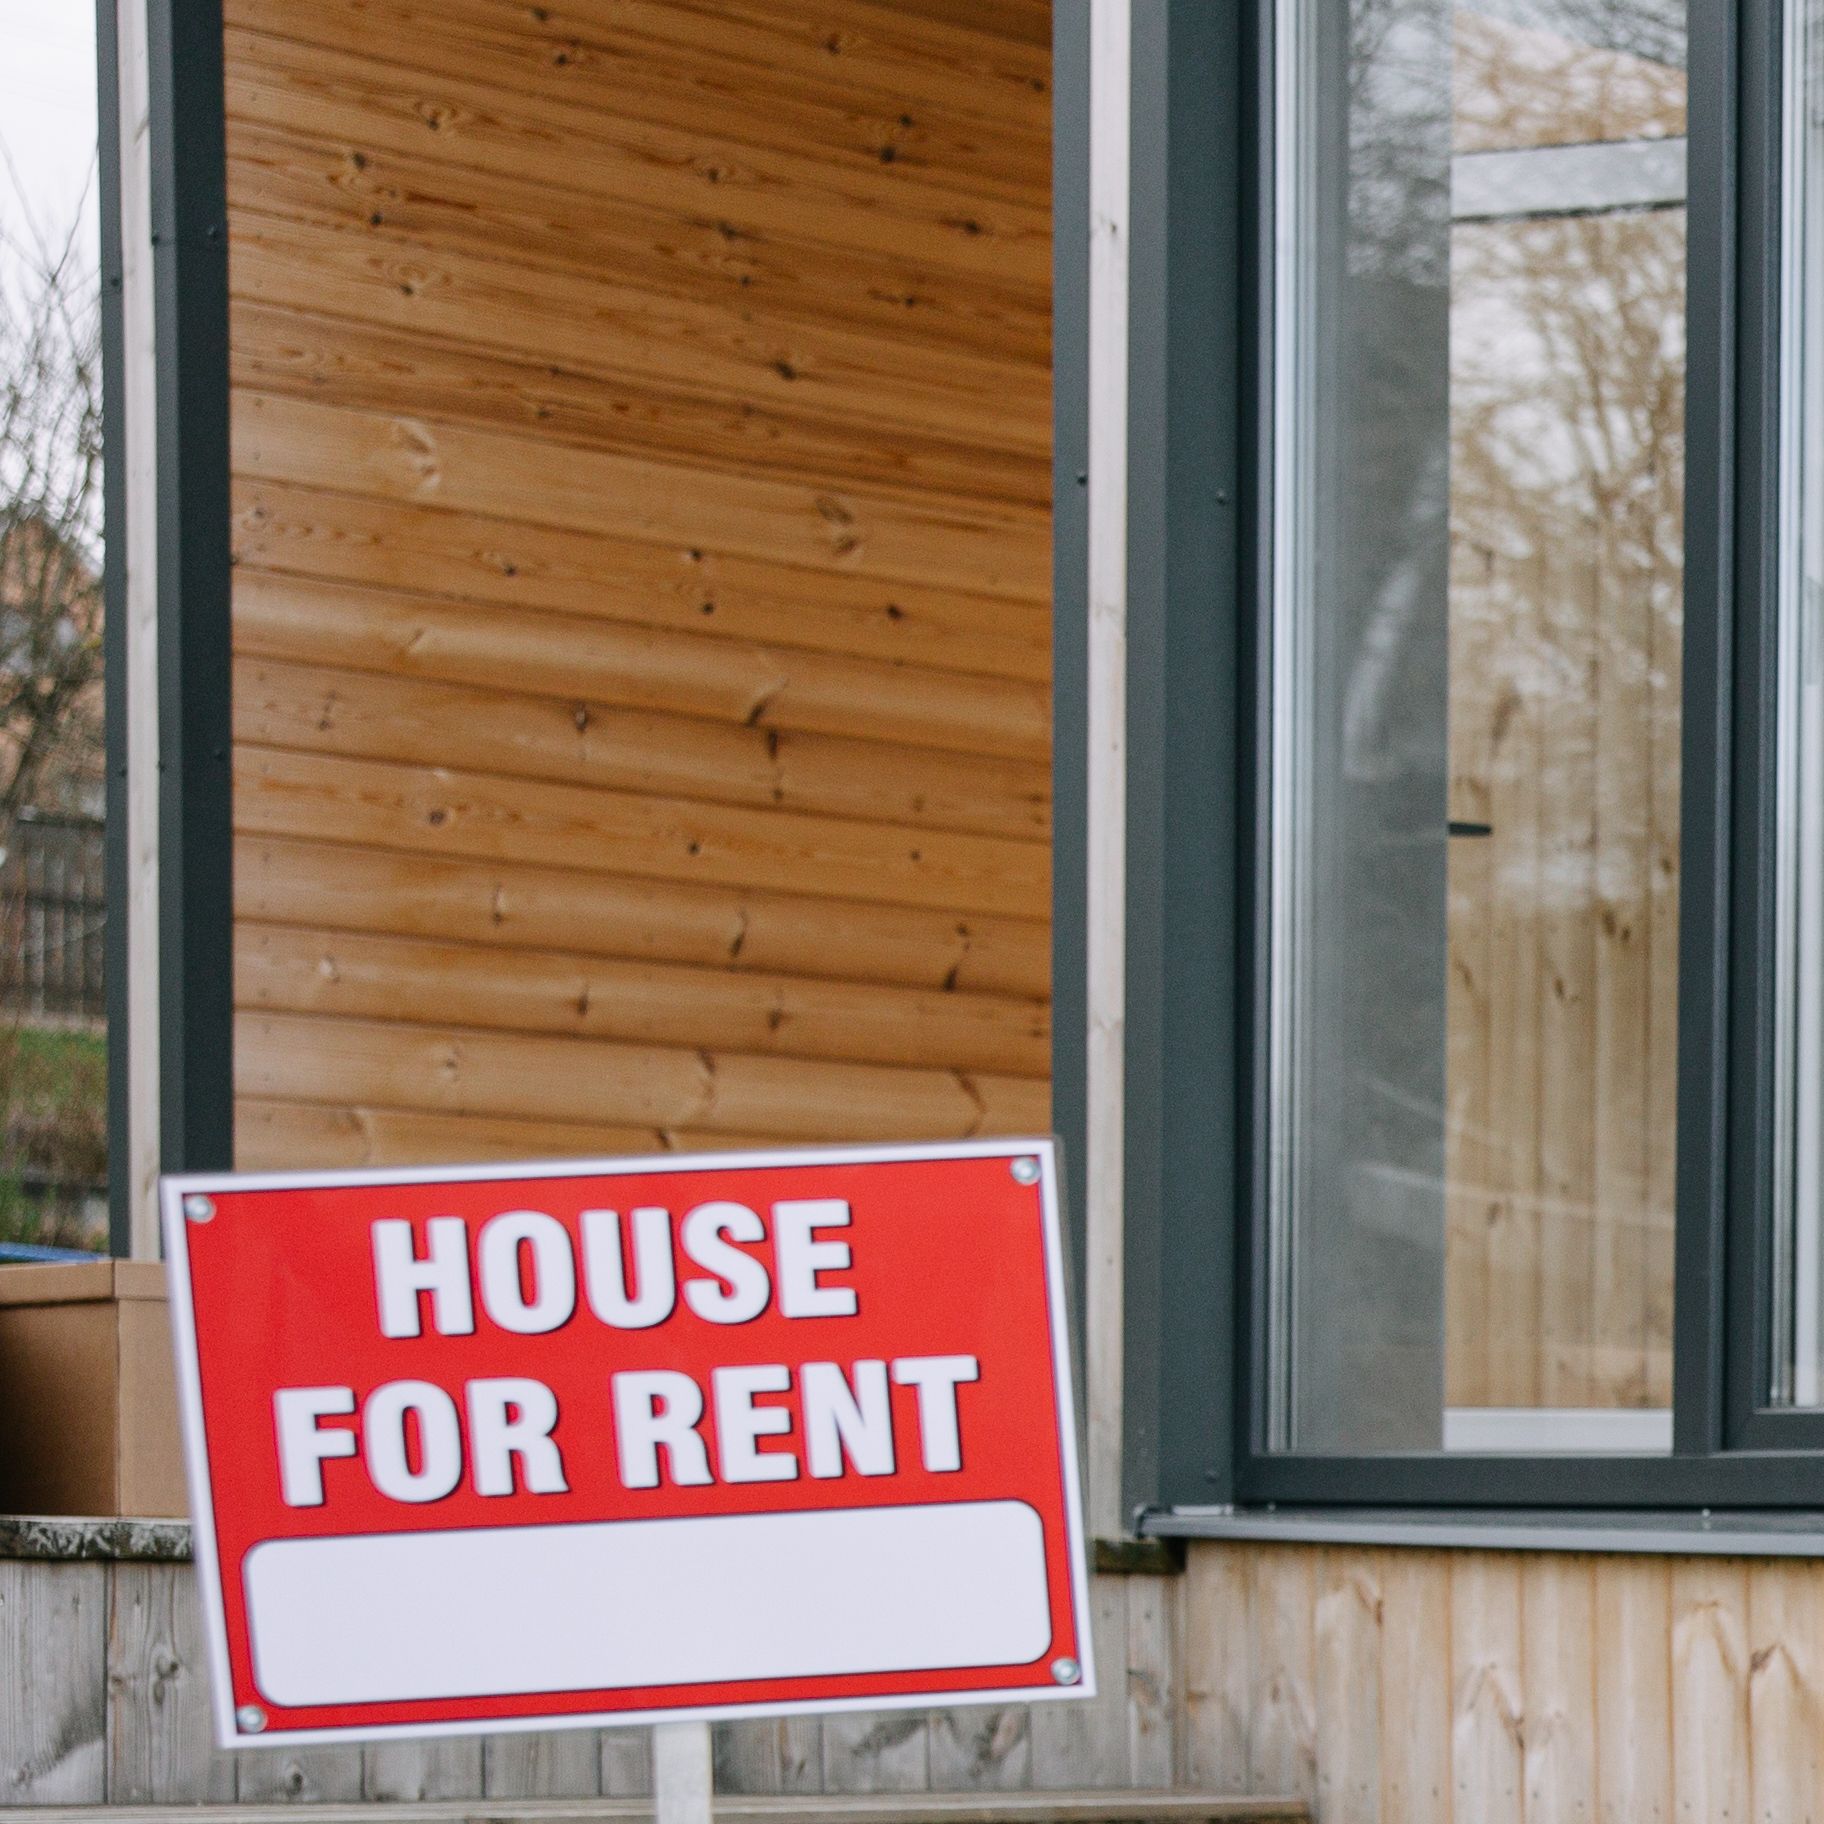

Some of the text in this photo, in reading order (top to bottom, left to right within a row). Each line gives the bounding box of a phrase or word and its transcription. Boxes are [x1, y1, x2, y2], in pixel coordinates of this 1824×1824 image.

[371, 1199, 858, 1339] HOUSE
[273, 1354, 980, 1507] FOR RENT
